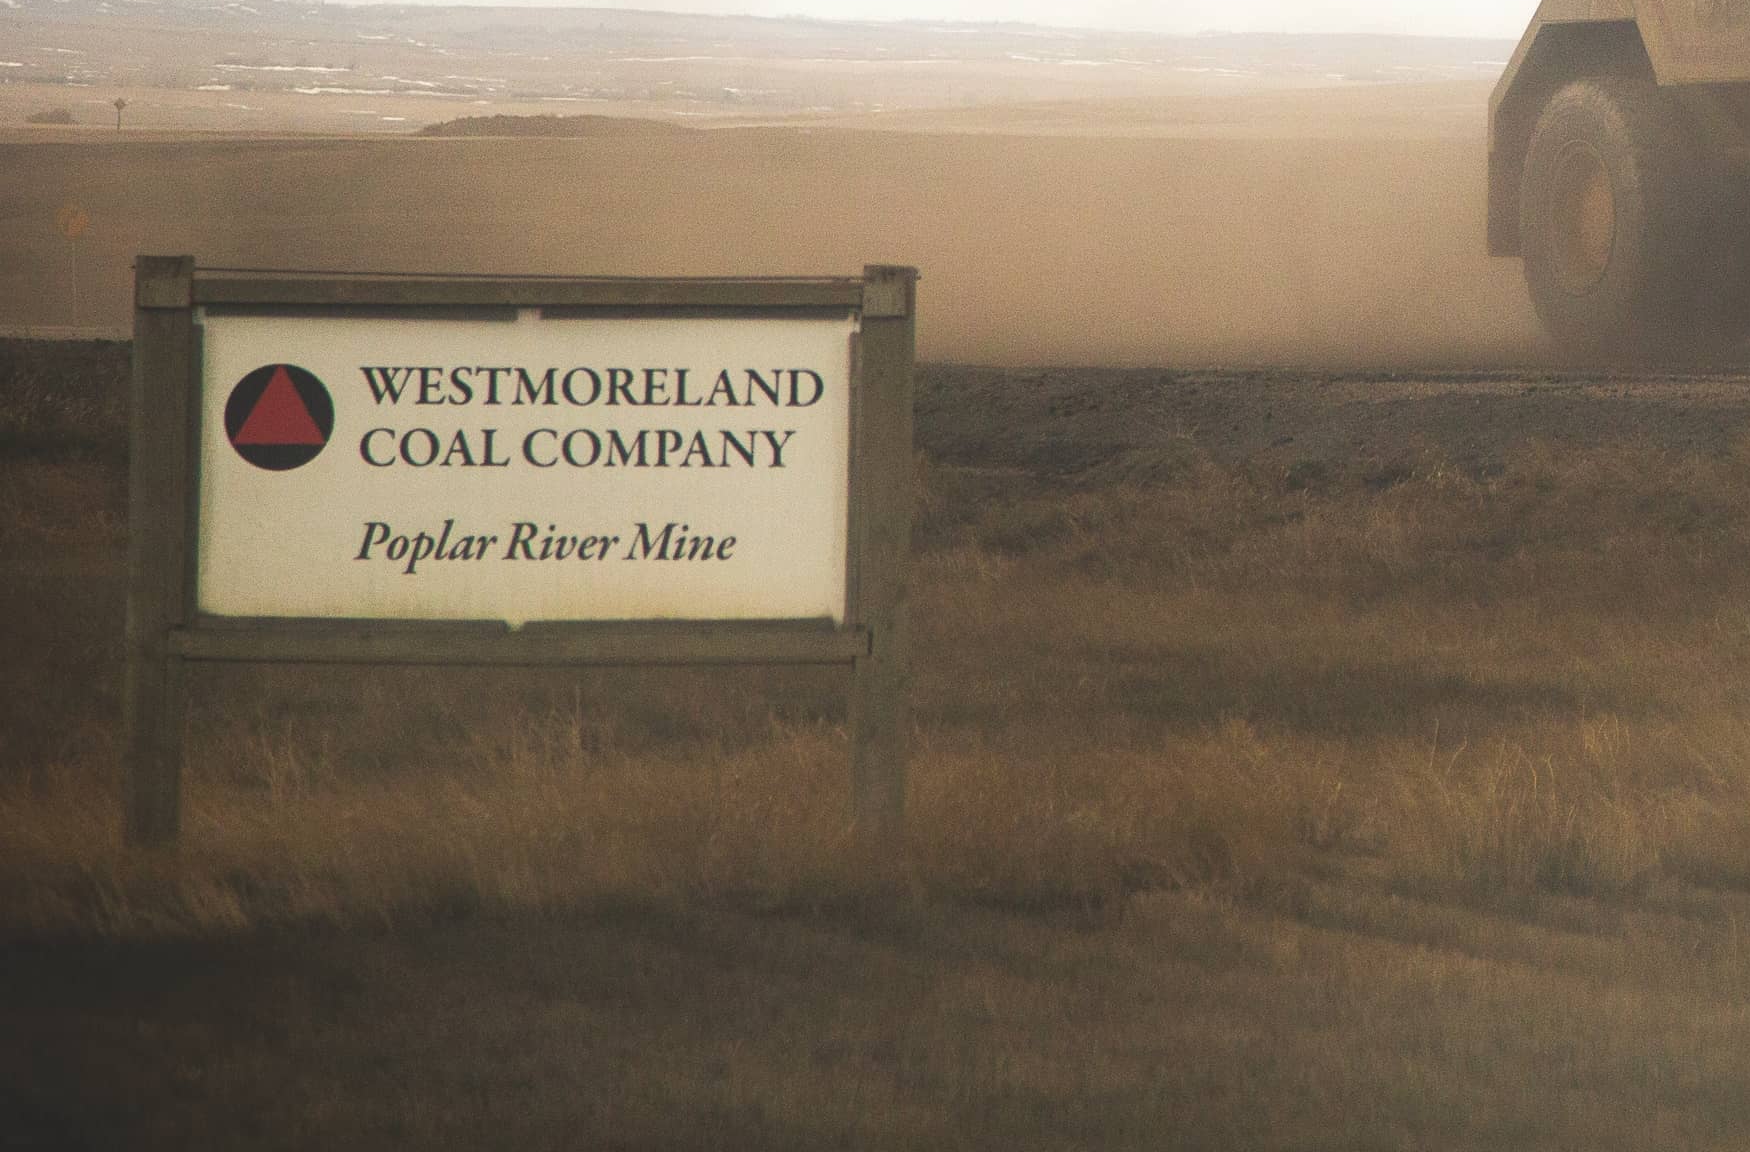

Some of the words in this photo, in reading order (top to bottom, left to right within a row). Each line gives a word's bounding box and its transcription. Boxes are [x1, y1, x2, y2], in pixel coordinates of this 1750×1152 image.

[358, 365, 825, 408] WESTMORELAND
[358, 427, 511, 468] COAL
[521, 427, 796, 468] COMPANY
[354, 519, 498, 575] Poplar
[501, 521, 619, 562] River
[622, 522, 737, 562] Mine
